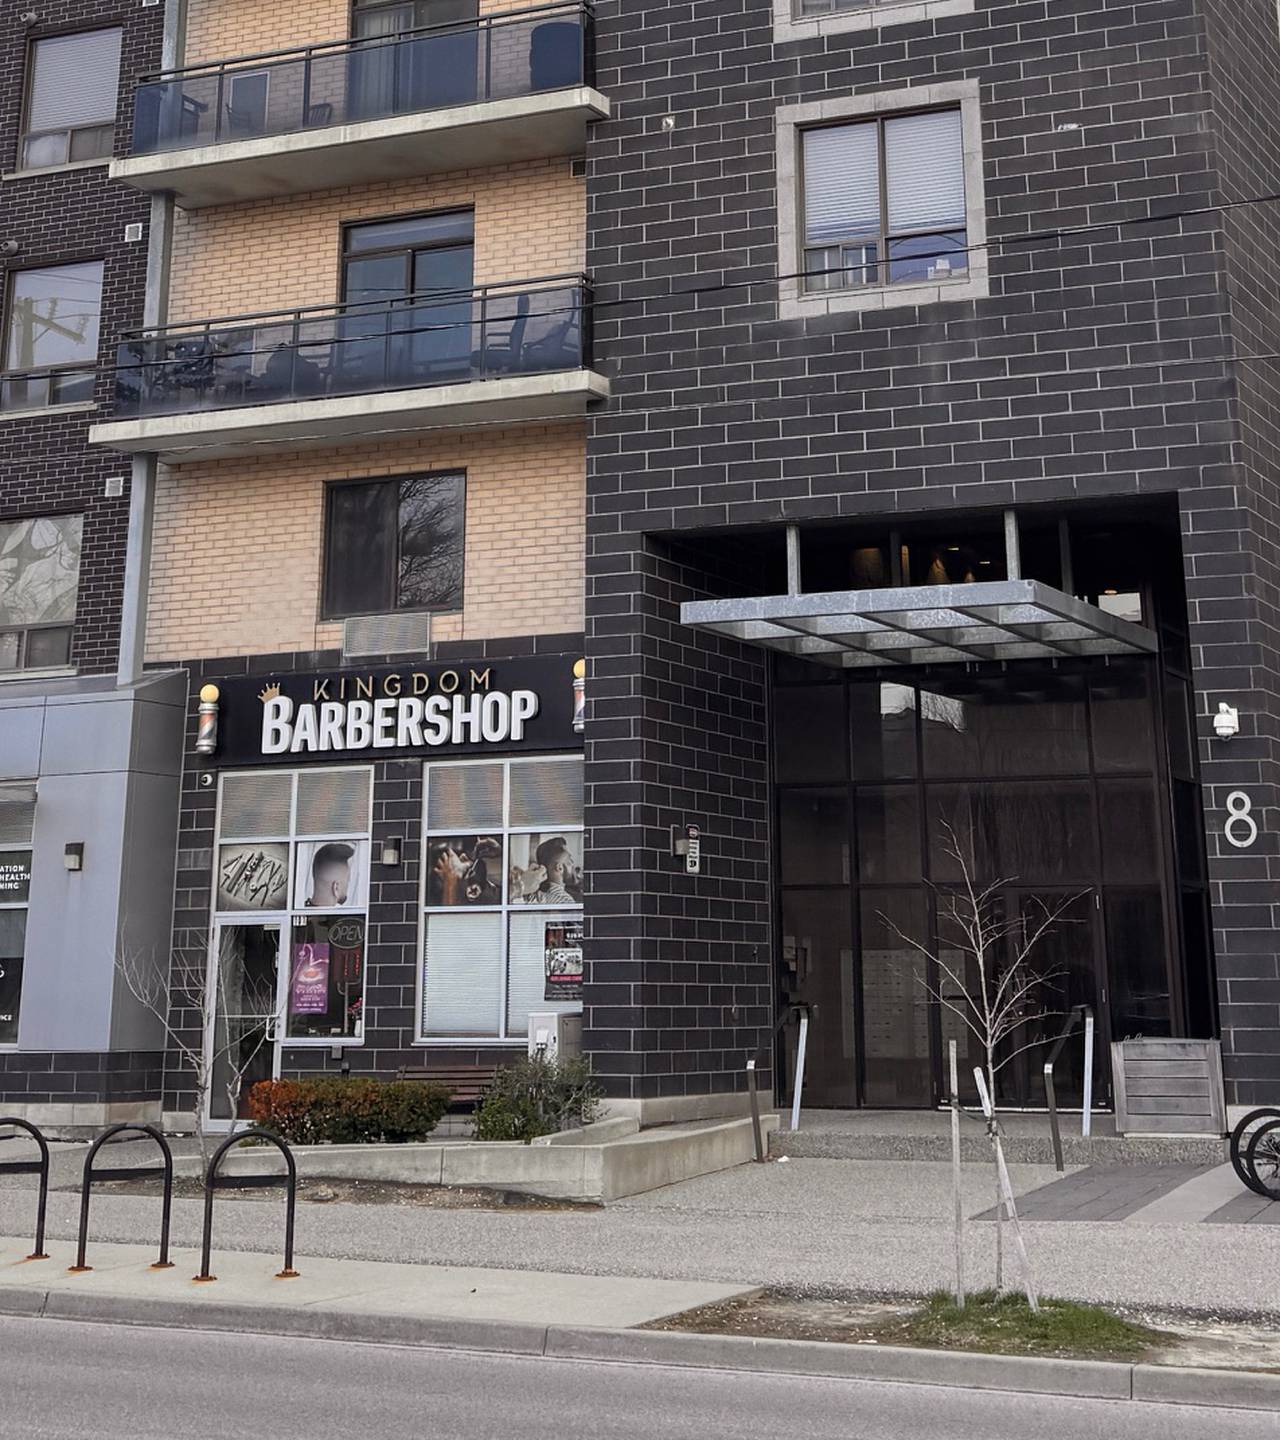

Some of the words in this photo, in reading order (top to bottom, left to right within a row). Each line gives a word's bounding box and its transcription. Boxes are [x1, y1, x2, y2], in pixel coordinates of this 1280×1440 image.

[313, 668, 492, 701] KINGDOM
[261, 690, 539, 754] BARBERSHOP
[1224, 790, 1258, 848] 8
[0, 873, 31, 881] HEALTH
[331, 925, 363, 941] OPEN
